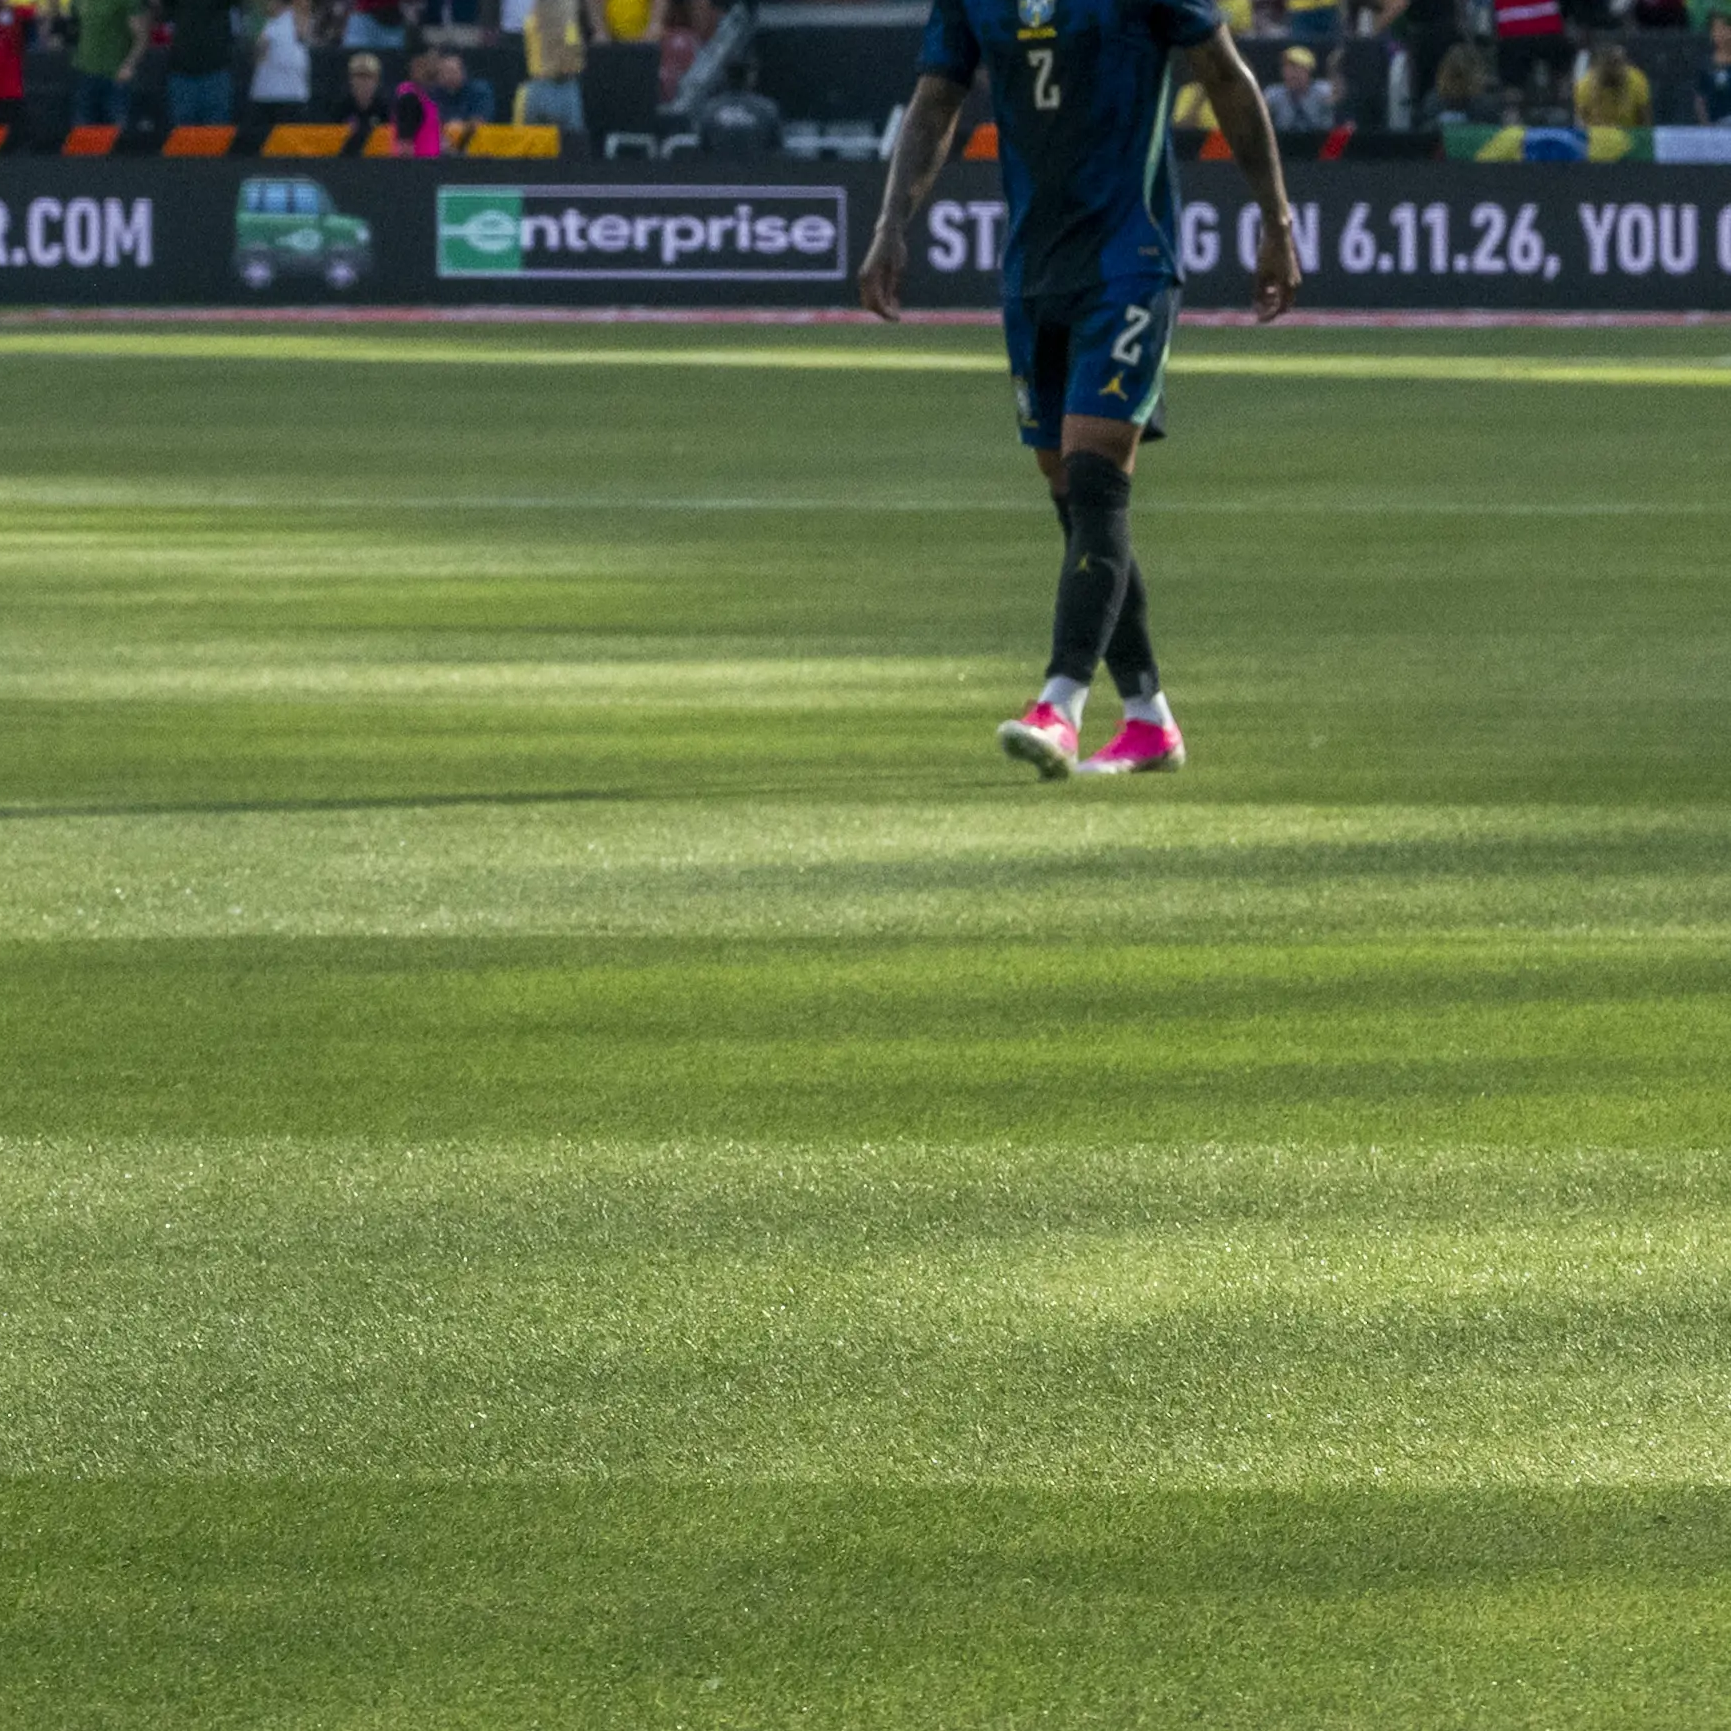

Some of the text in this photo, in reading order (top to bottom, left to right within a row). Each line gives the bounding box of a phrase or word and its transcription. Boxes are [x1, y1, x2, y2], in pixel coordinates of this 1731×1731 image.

[1027, 49, 1060, 109] 2
[459, 204, 837, 264] enterprise
[1338, 201, 1562, 282] 6.11.26,
[1578, 202, 1699, 276] YOU
[1111, 304, 1151, 366] 2
